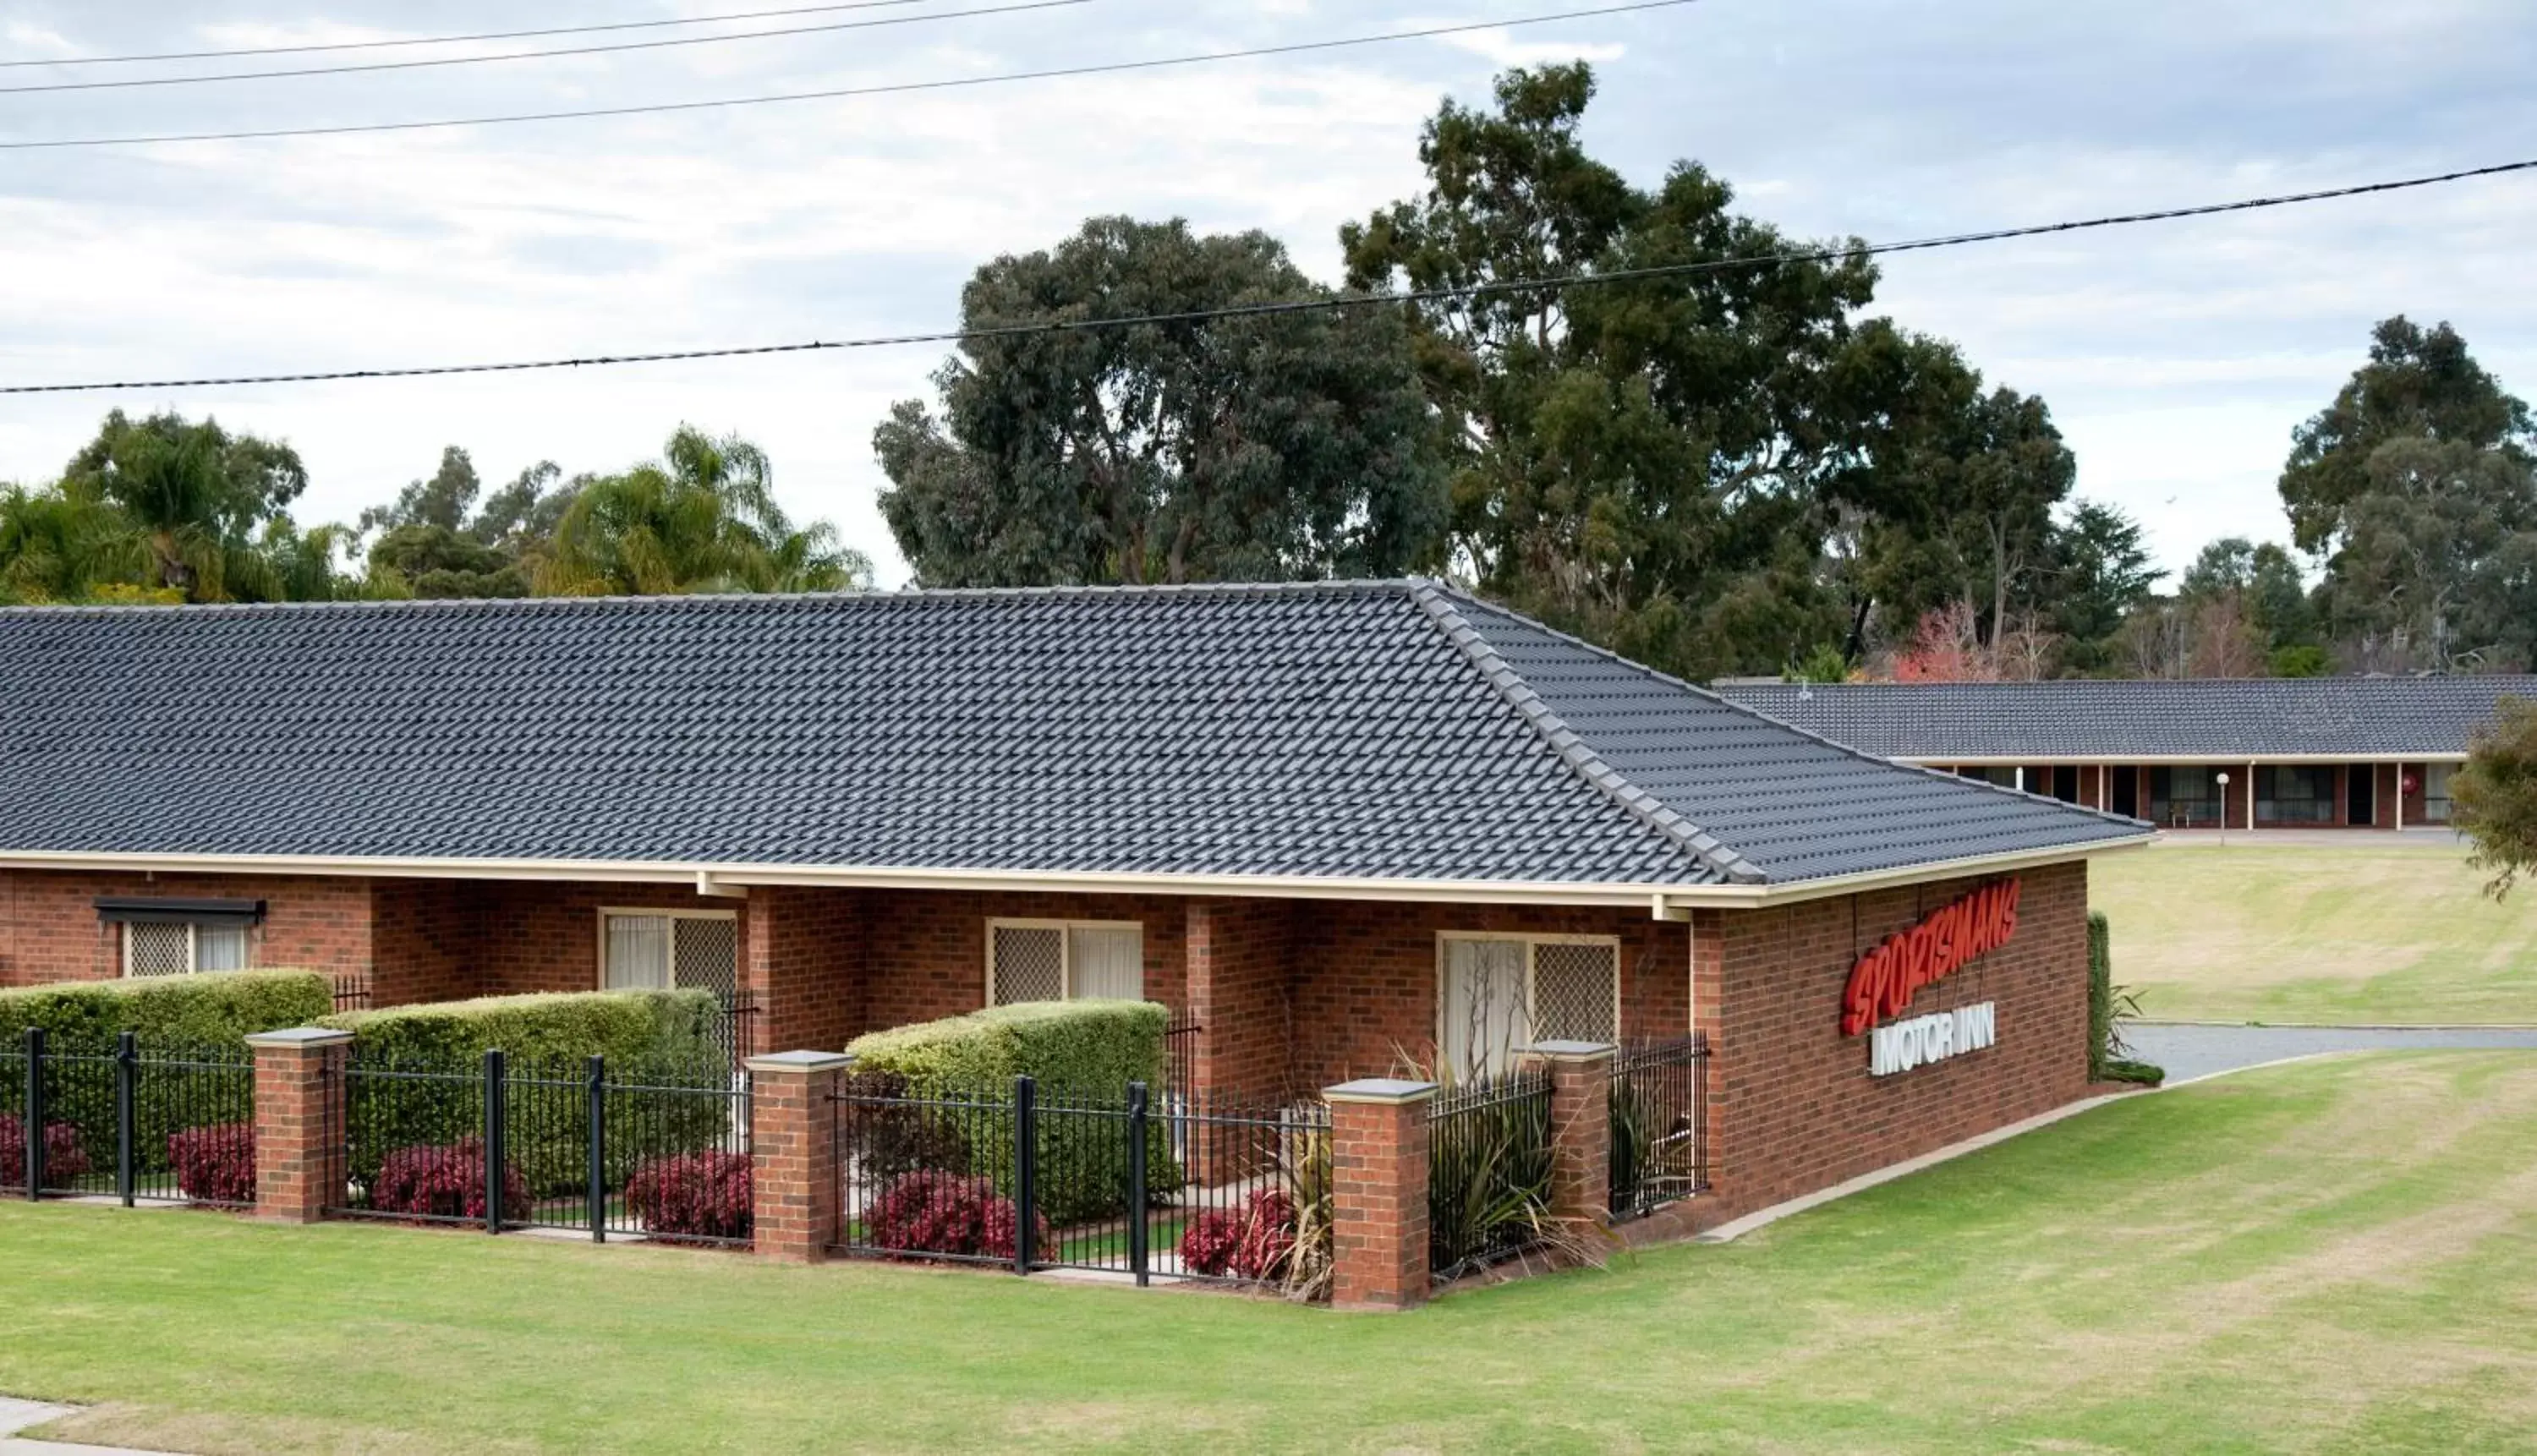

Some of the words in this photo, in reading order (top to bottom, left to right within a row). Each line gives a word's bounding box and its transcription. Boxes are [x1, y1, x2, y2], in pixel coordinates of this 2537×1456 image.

[1844, 876, 2021, 1036] SPORTSMANS
[1871, 1012, 1953, 1076] MOTOR
[1954, 1001, 1995, 1054] INN
